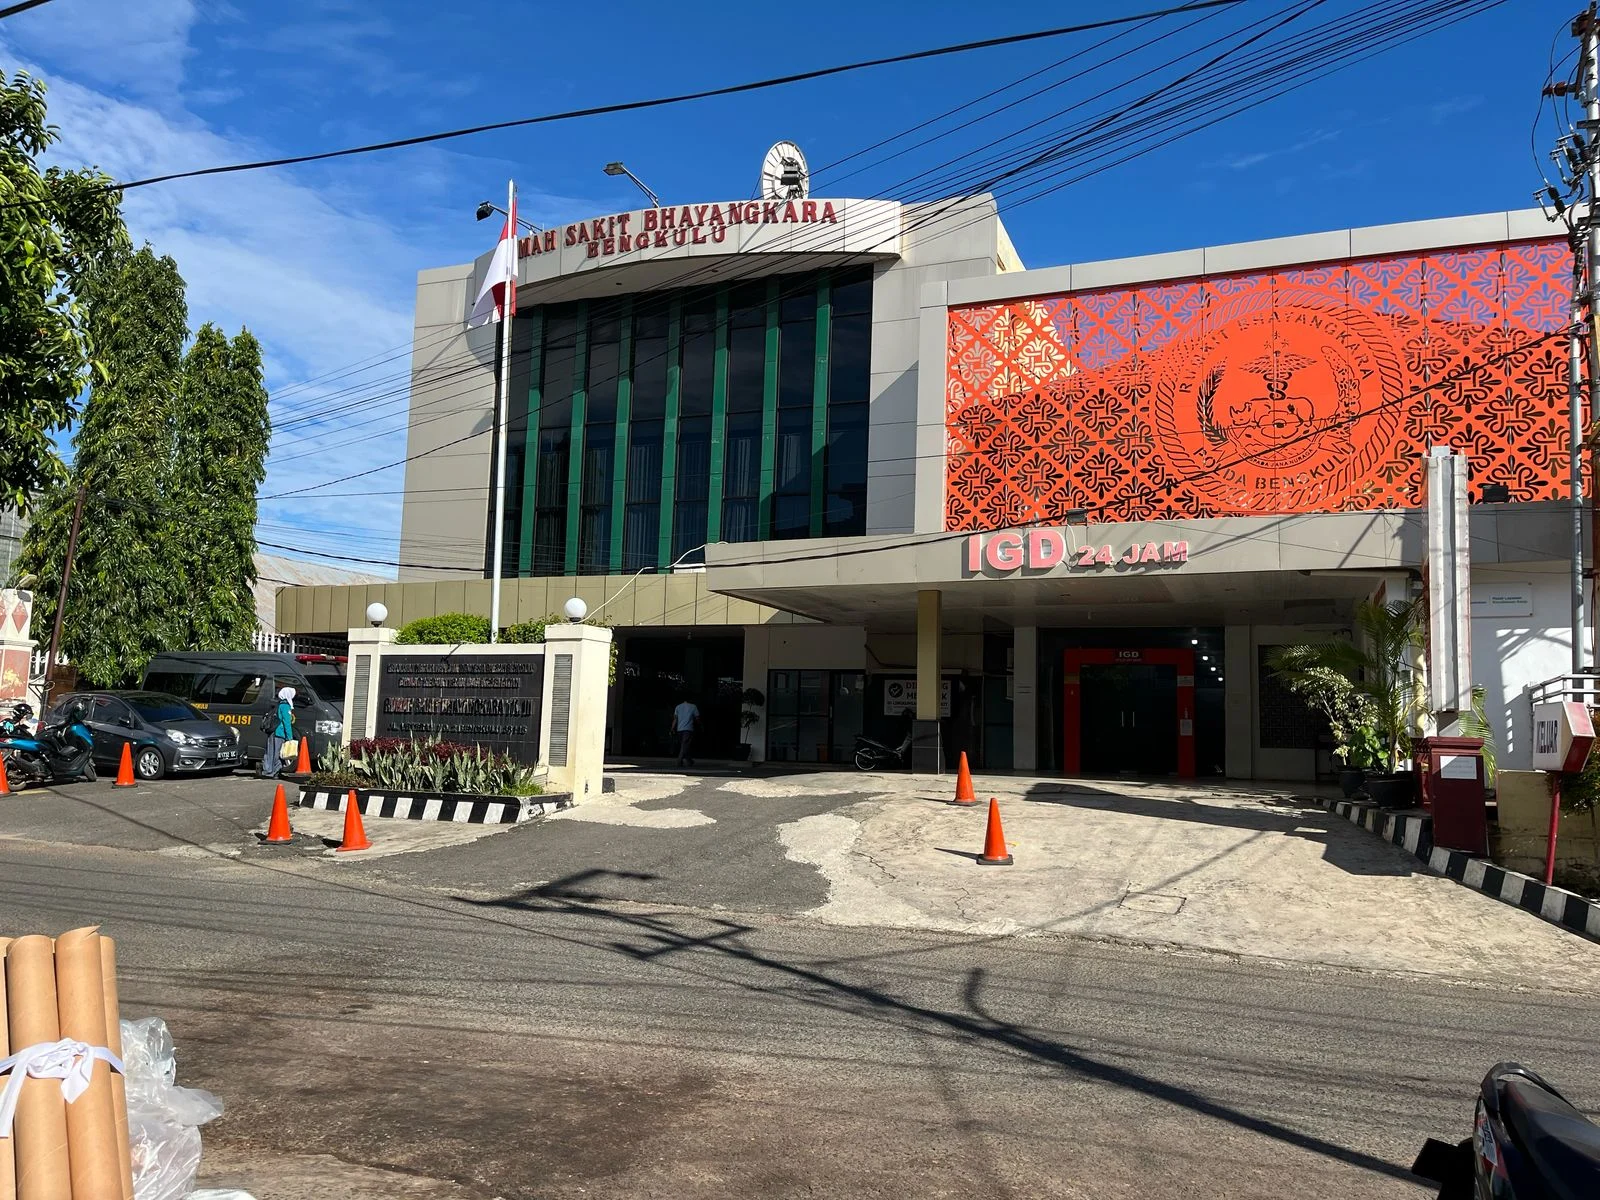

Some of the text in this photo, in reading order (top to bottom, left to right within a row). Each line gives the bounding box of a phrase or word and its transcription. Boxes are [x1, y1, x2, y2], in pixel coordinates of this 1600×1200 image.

[517, 200, 838, 259] MAH SAKIT BHAYANGKARA
[587, 225, 727, 258] BENGKULU
[1255, 442, 1357, 490] BENGKULU
[968, 529, 1189, 572] IGD 24 JAM
[218, 714, 251, 725] POLISI
